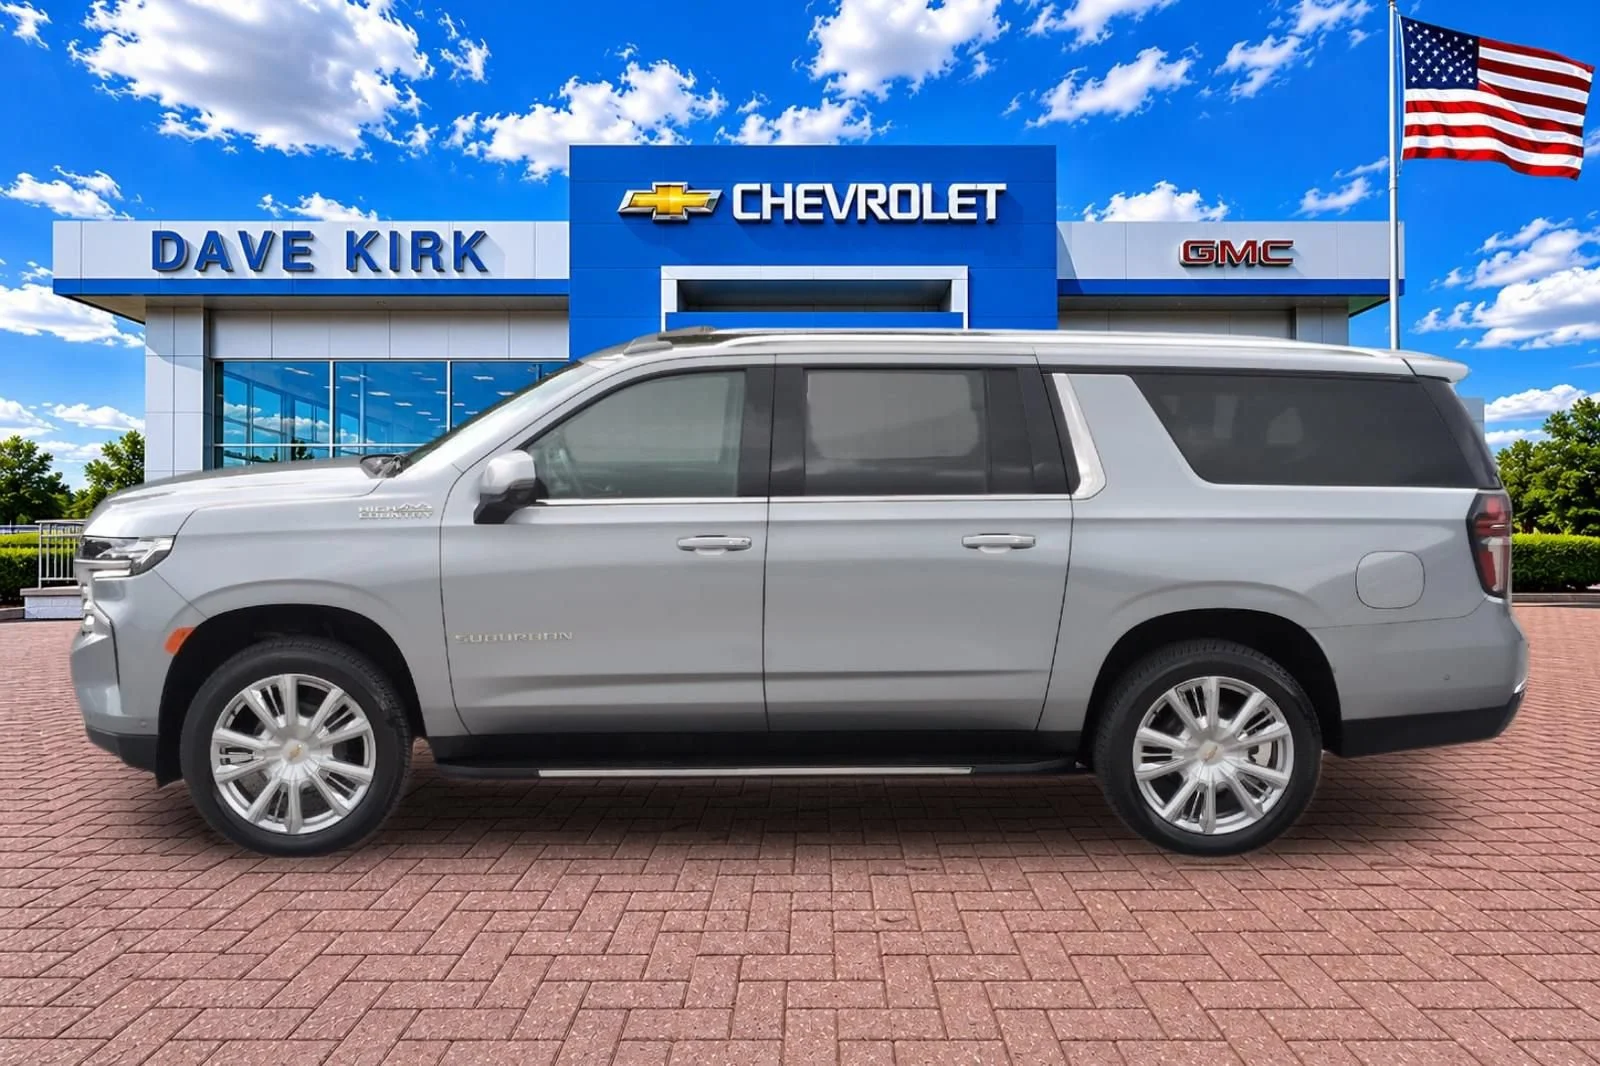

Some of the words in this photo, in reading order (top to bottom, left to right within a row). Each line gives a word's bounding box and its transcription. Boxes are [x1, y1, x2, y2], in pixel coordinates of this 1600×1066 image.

[732, 183, 1007, 222] CHEVROLET
[151, 230, 314, 273] DAVE
[346, 230, 488, 273] KIRK
[1180, 239, 1294, 267] GMC
[455, 631, 574, 644] SUBURBAN
